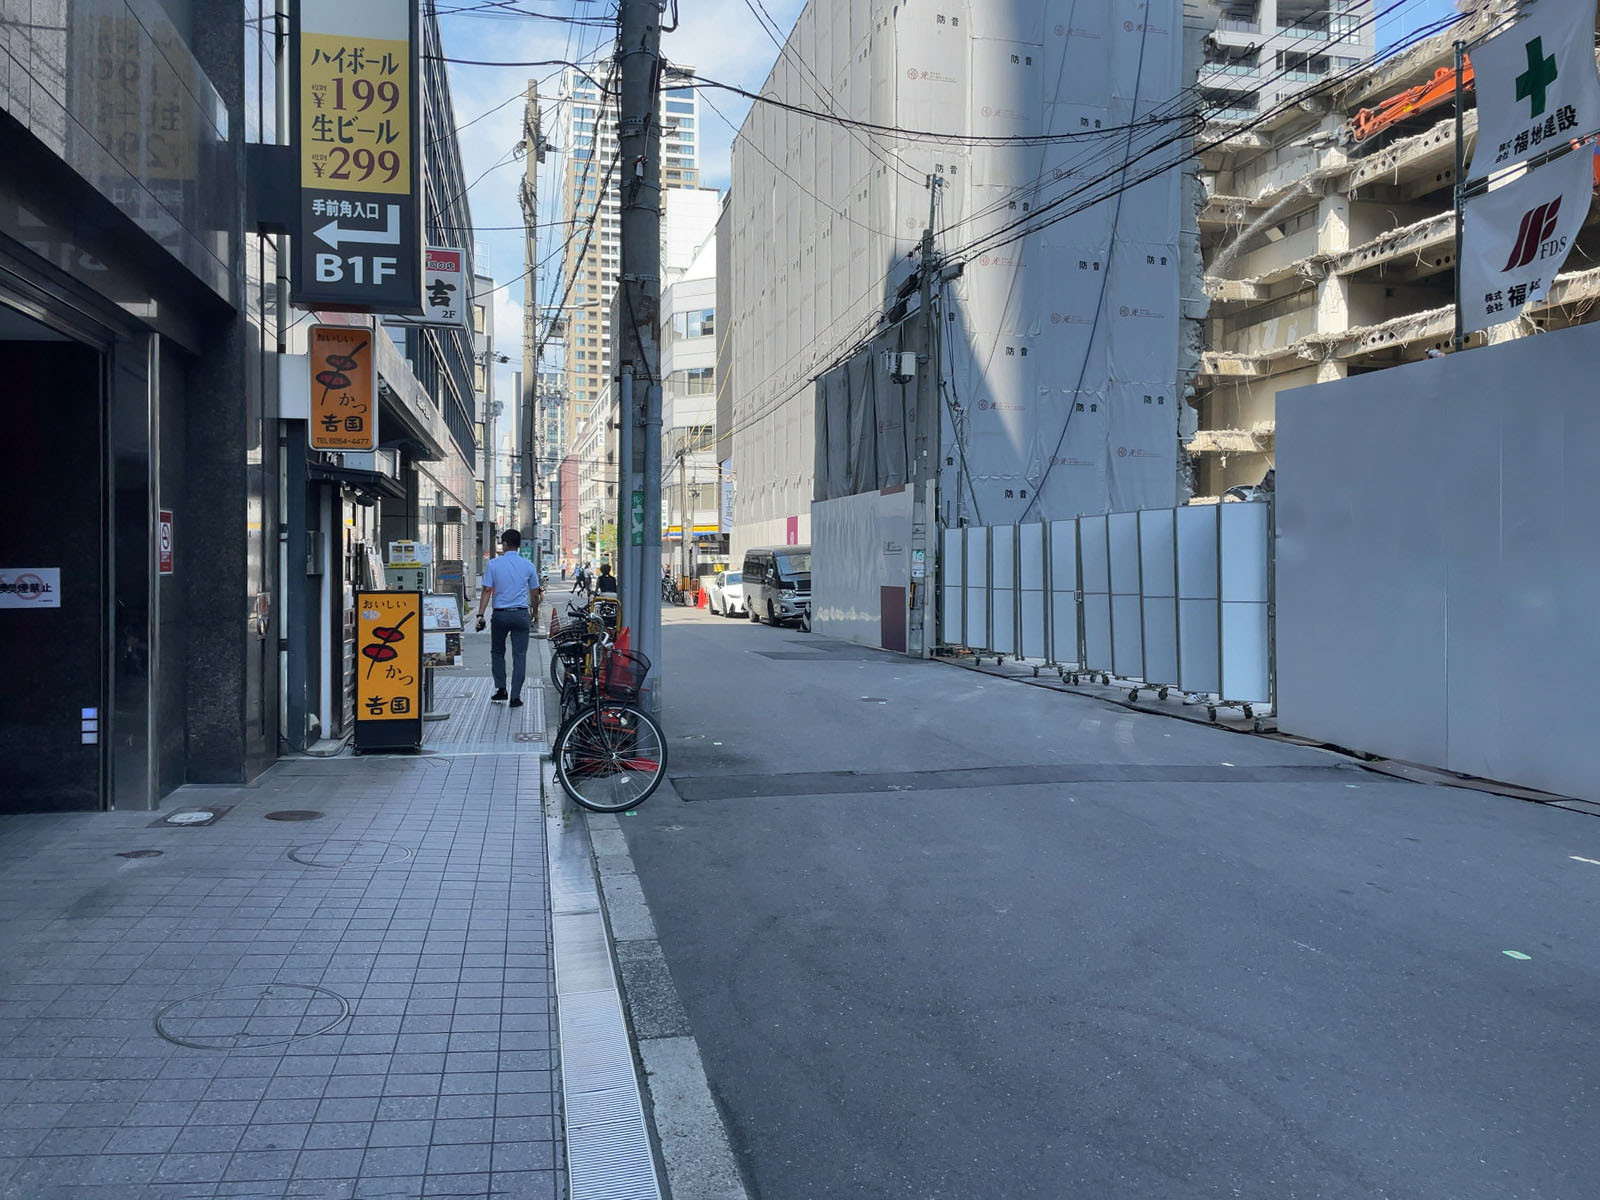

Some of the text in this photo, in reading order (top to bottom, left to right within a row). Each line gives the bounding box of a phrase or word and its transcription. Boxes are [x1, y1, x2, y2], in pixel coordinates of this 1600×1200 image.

[311, 46, 399, 75] ハイボール
[311, 114, 400, 144] 生ビール
[1513, 104, 1579, 155] 福地建設
[312, 199, 379, 219] 手前角入口
[1540, 236, 1567, 260] FDS
[1080, 261, 1100, 271] 防音
[1147, 256, 1168, 266] 防音
[316, 253, 397, 284] B1F
[442, 310, 456, 319] 2F
[1006, 347, 1028, 357] 防音
[1143, 395, 1165, 405] 防音
[1076, 403, 1097, 413] 防音
[1005, 489, 1027, 499] 防音
[363, 600, 407, 609] おいしい
